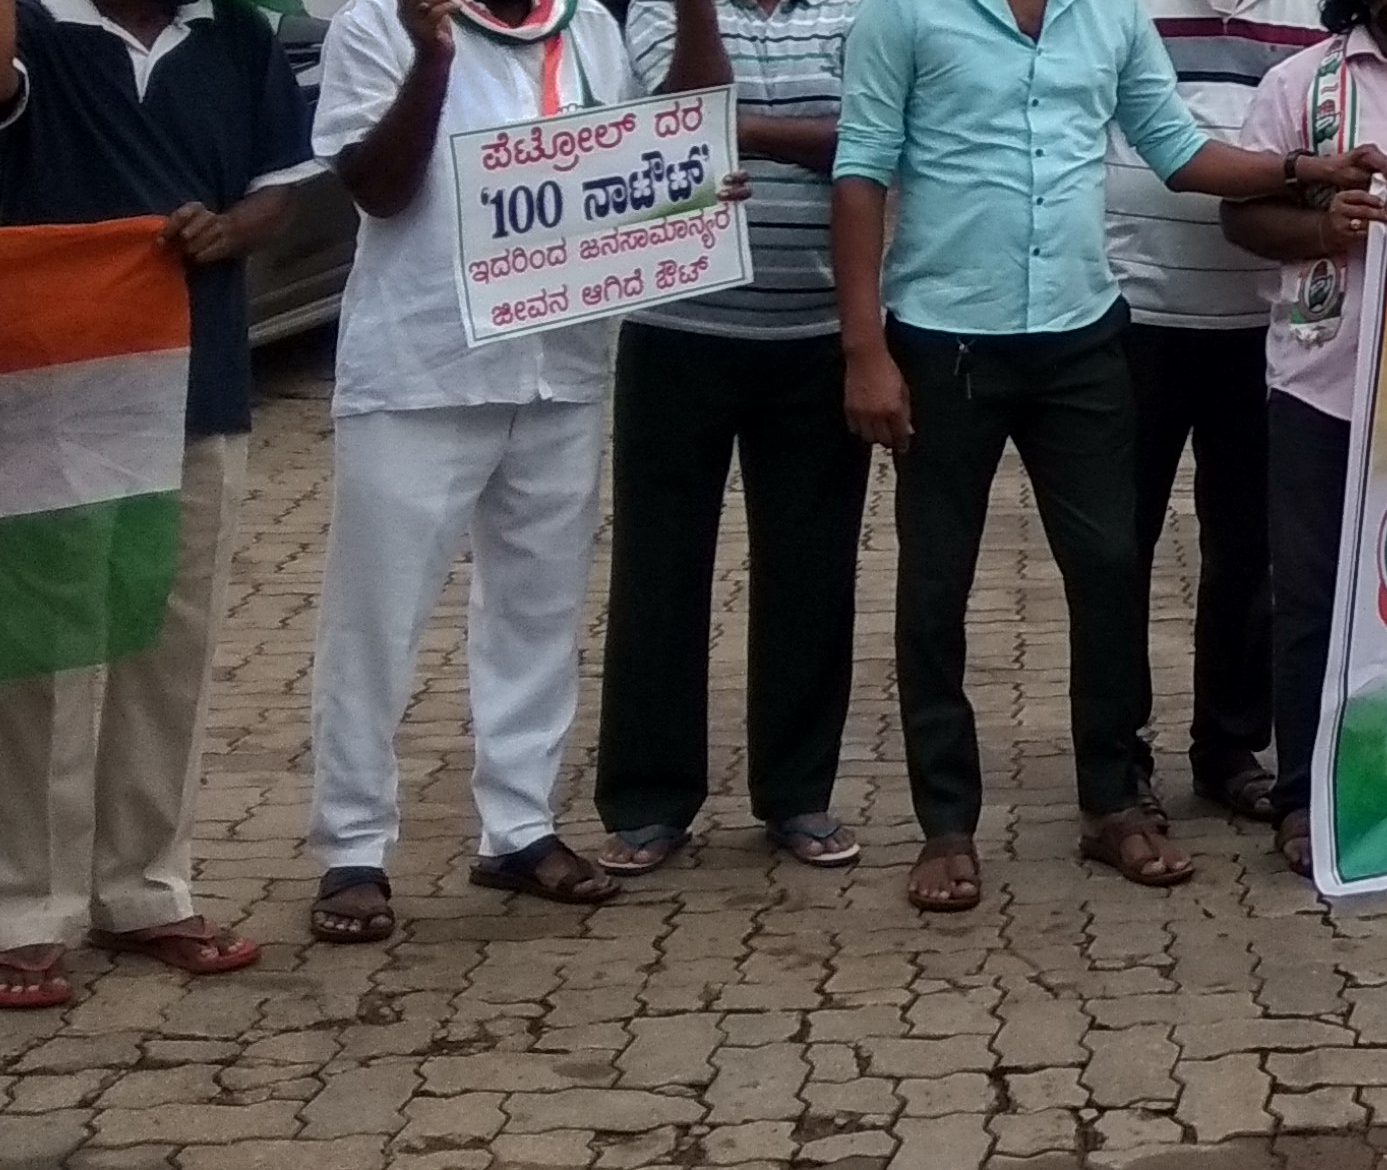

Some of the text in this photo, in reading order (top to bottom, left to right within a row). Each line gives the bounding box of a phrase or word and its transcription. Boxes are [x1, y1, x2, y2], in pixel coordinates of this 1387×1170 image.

[481, 97, 703, 171] ಪೆಟ್ರೋಲ್ ದರ
[469, 204, 730, 284] ಇದರಿಂದ ಜನಸಾಮಾನ್ಯರ
[492, 255, 708, 326] ಜೀವನ ಆಗಿದೆ ಔಟ್
